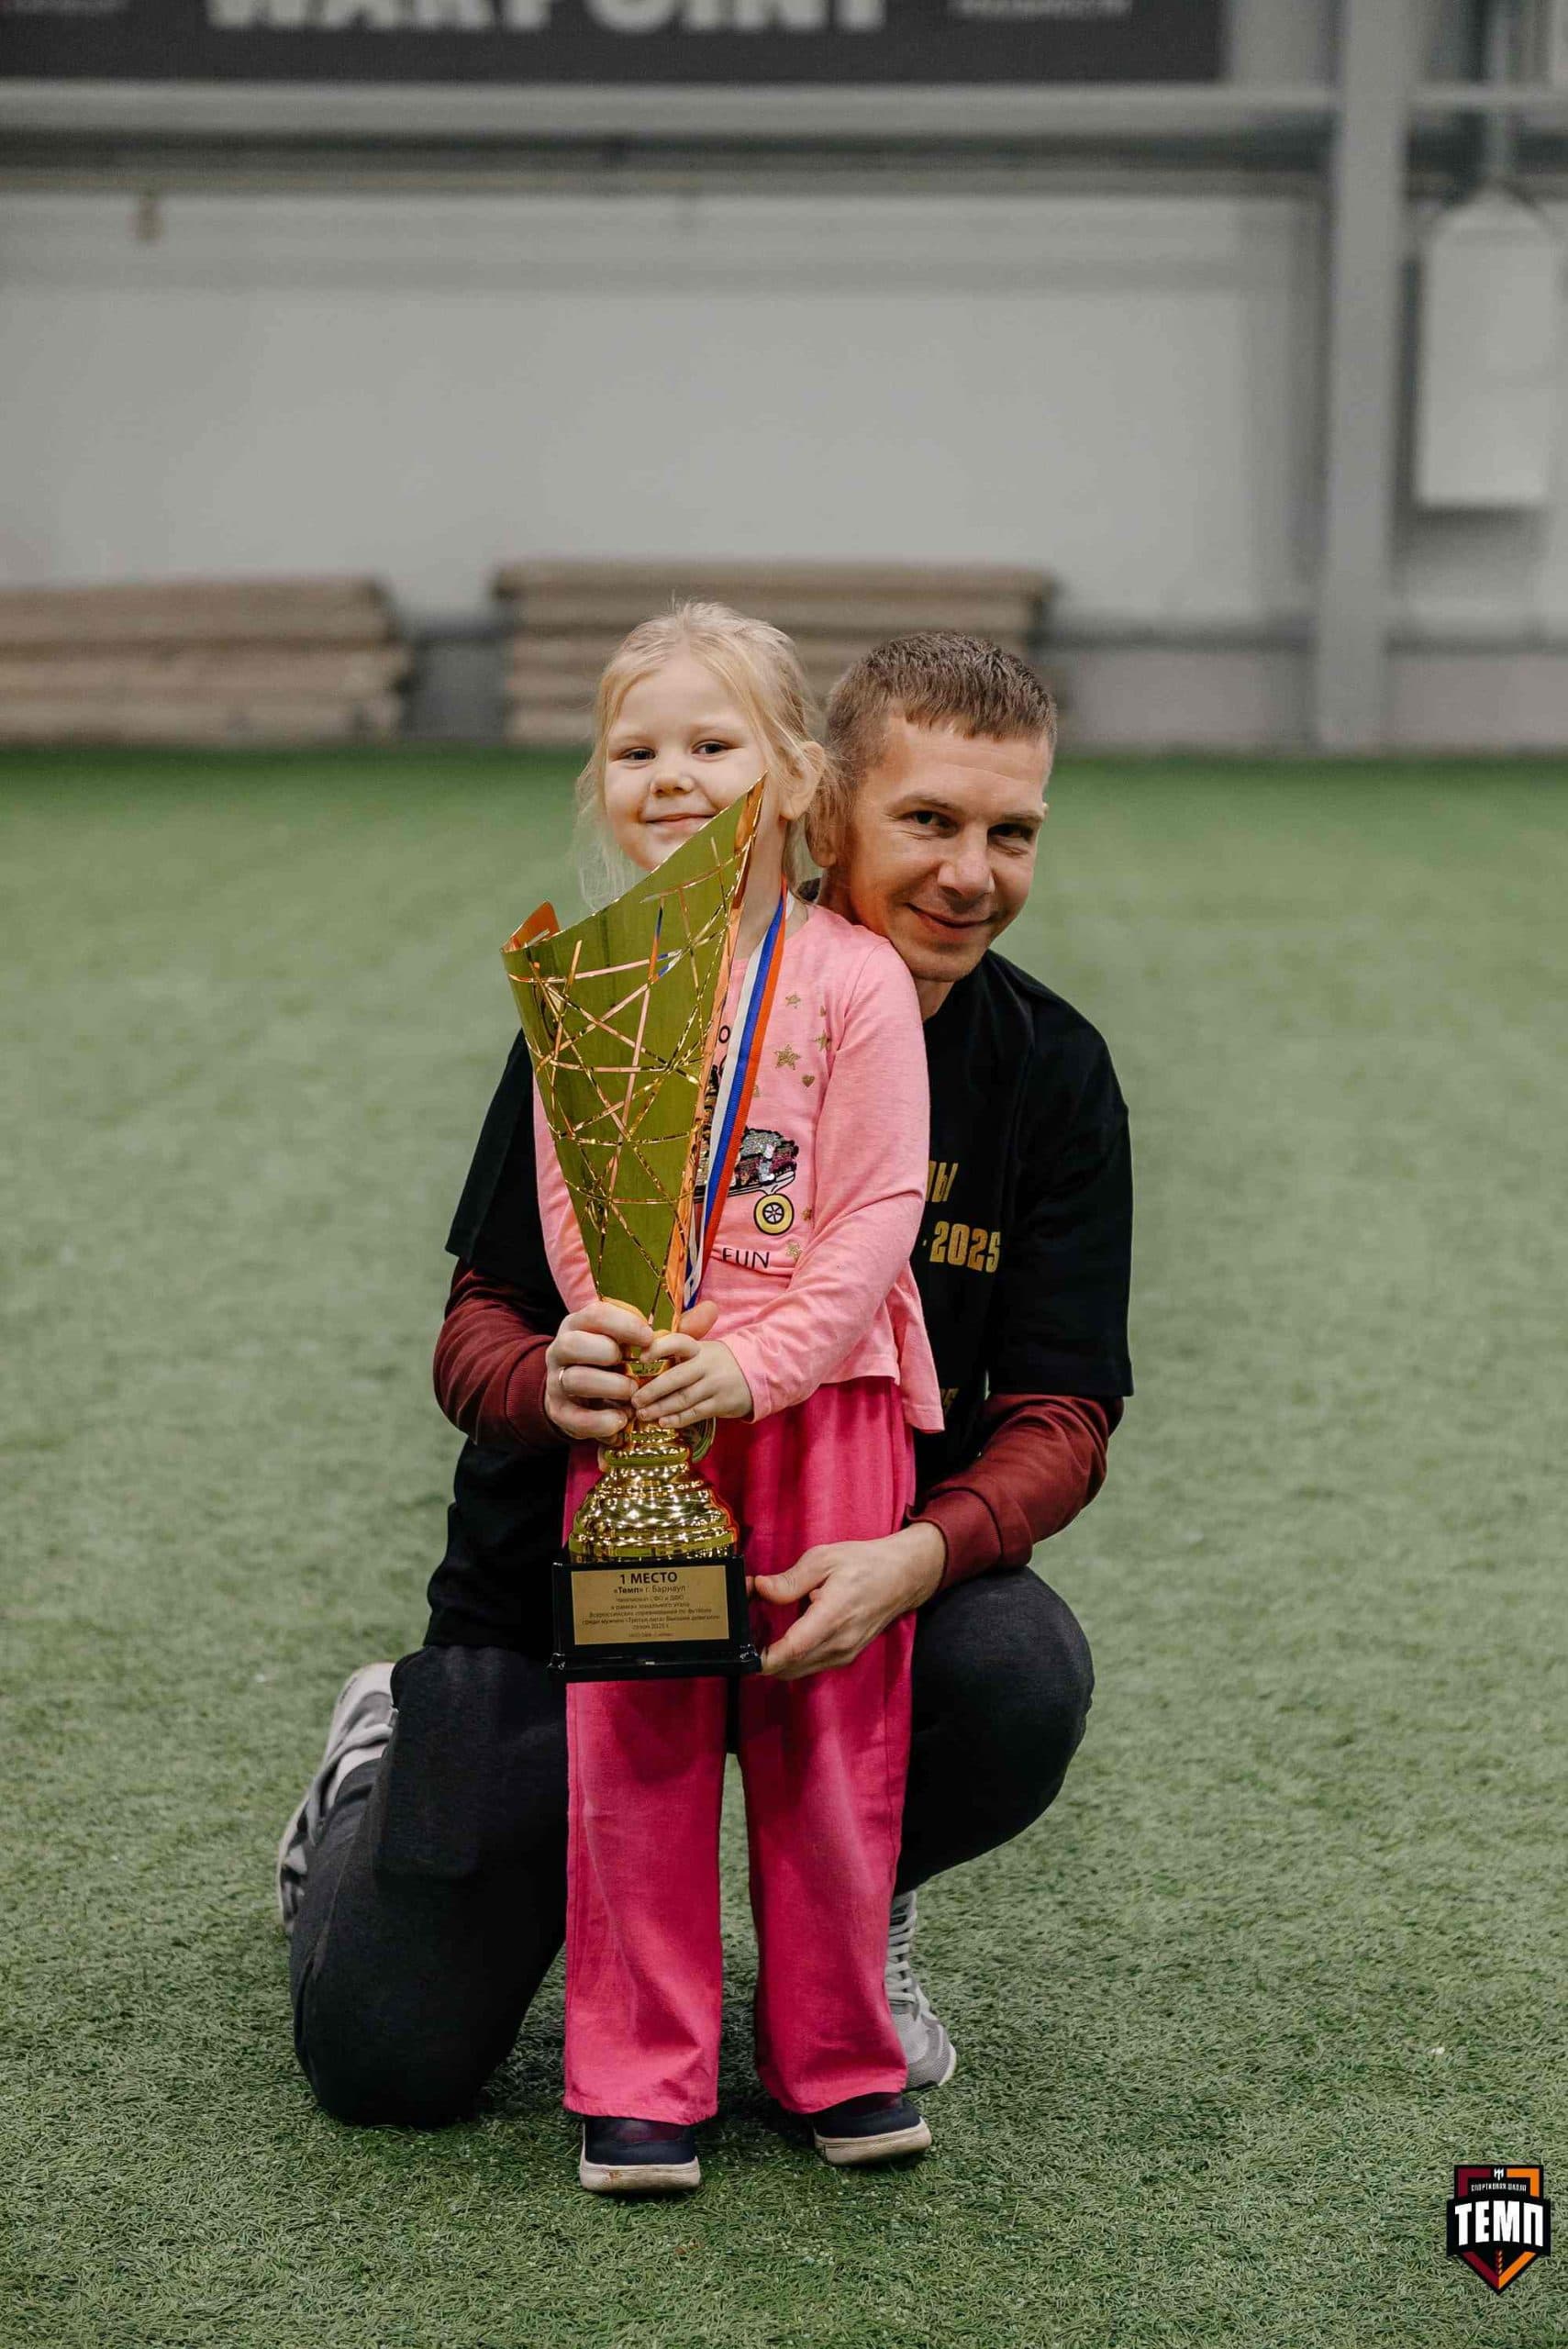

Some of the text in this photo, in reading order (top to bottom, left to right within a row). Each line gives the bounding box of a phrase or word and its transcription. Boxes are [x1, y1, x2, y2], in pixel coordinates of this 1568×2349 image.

[929, 1220, 1001, 1274] 2025
[722, 1247, 770, 1269] FUN
[618, 1571, 678, 1585] 1 МЕСТО
[651, 1585, 686, 1594] Барнаул
